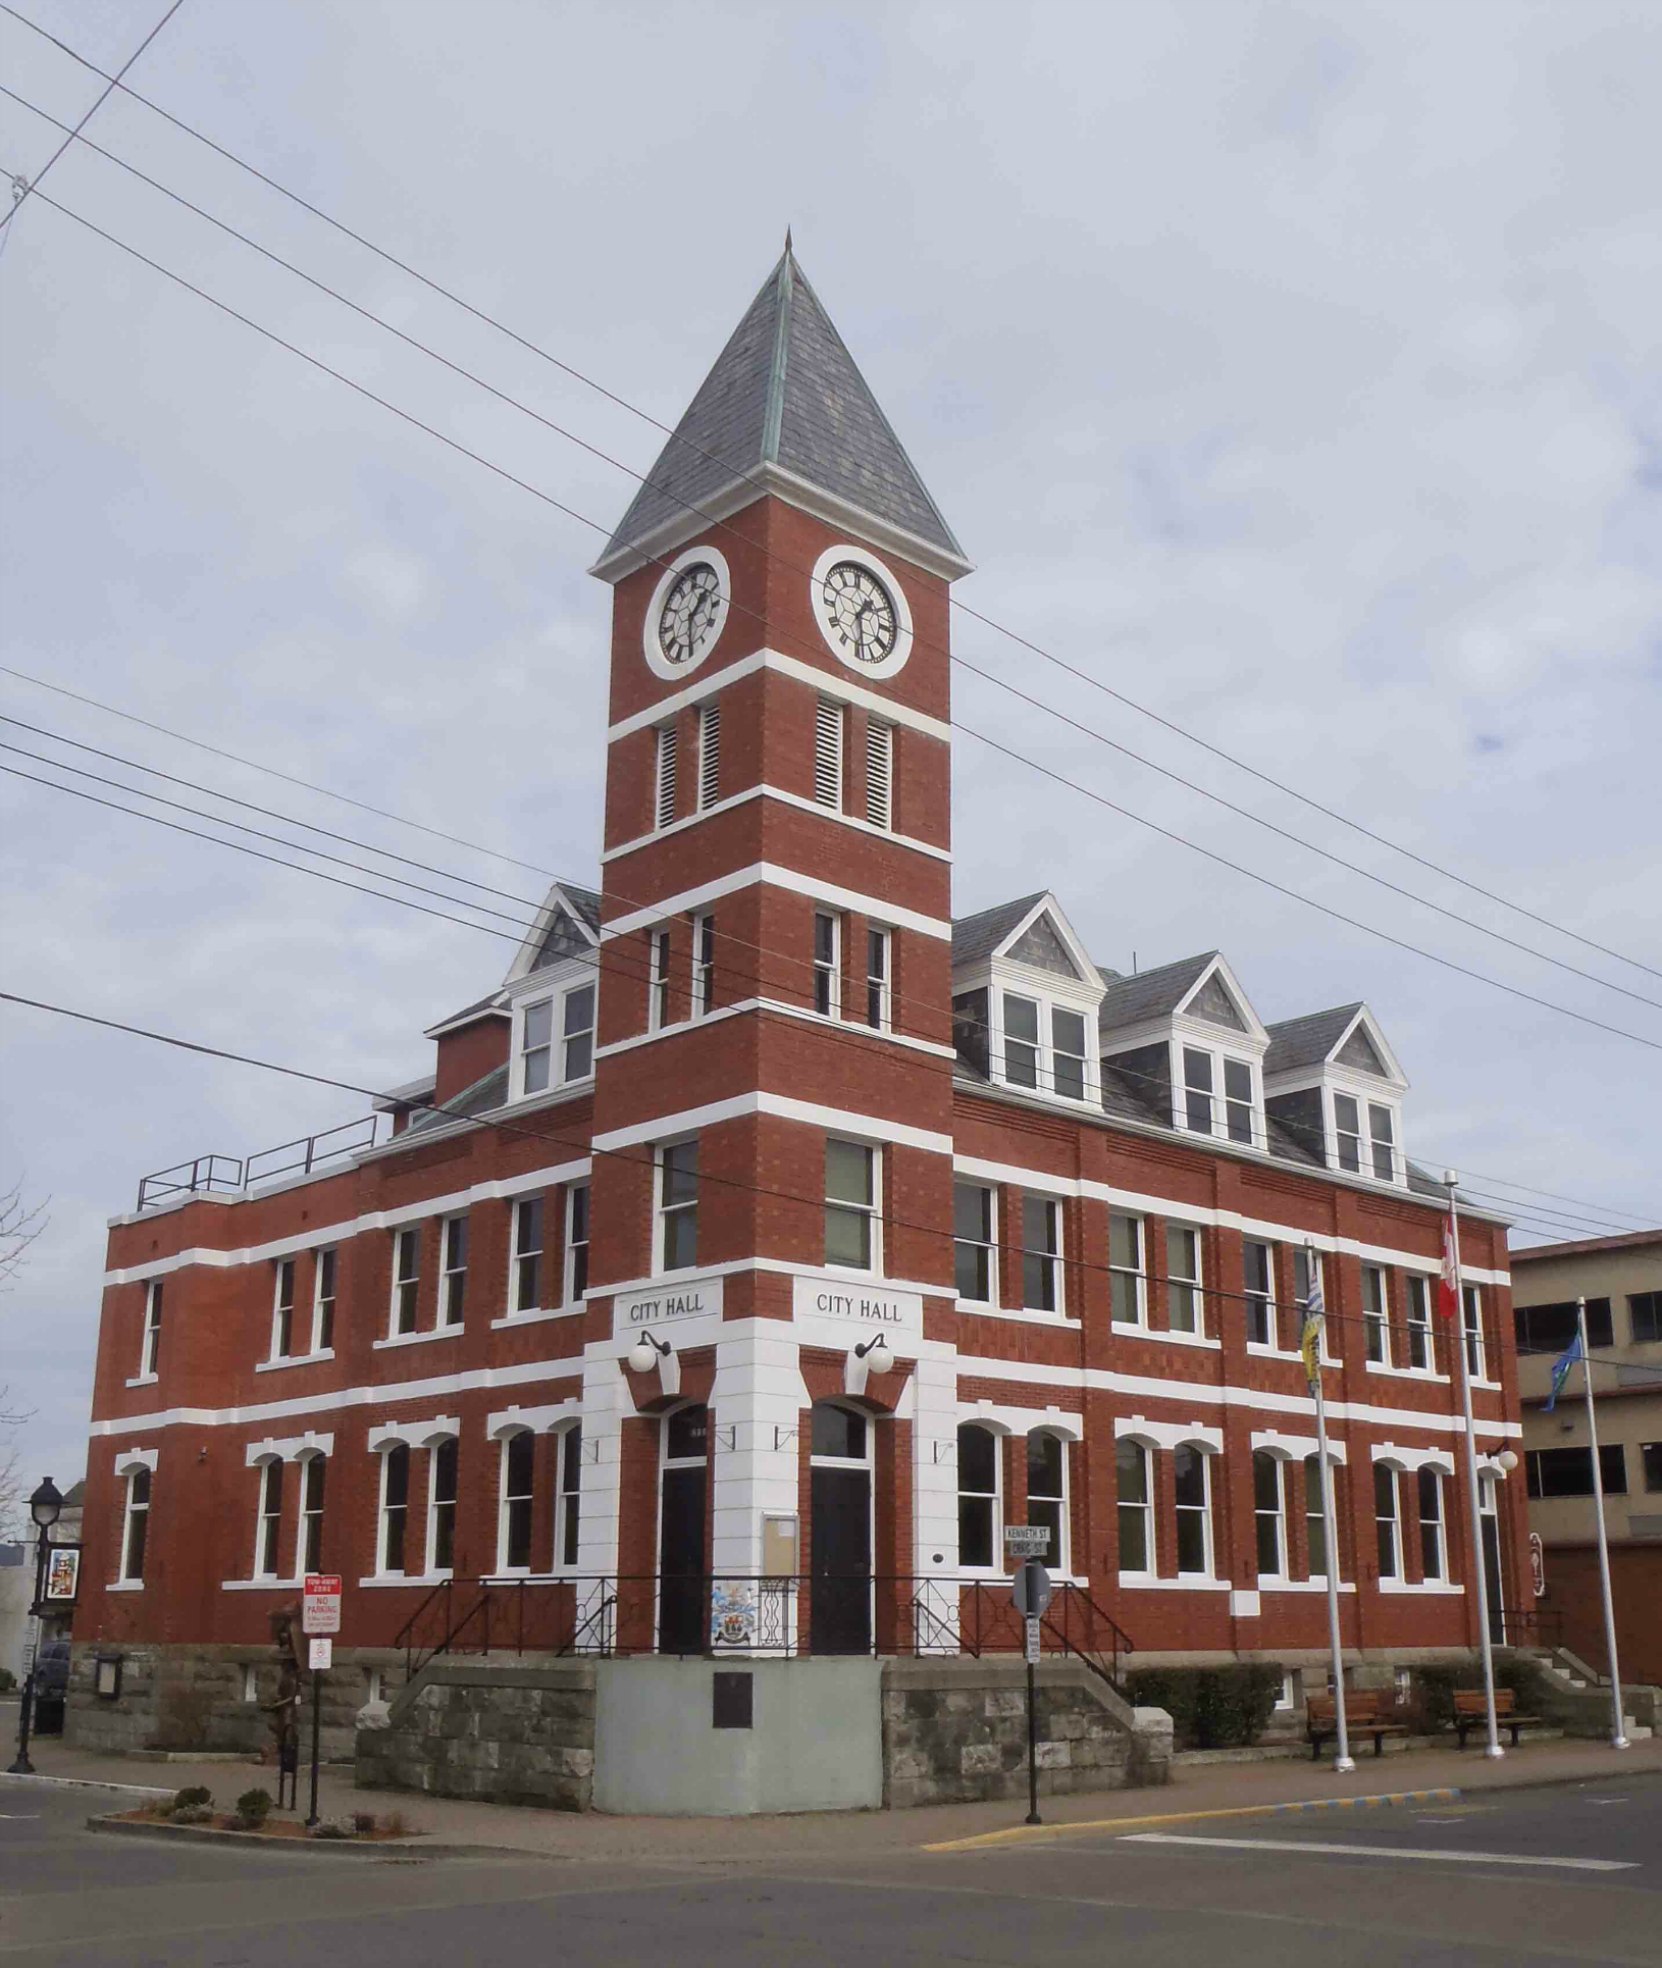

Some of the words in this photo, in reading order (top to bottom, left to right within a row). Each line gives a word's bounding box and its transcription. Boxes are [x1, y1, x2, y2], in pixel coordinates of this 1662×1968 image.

[630, 1300, 661, 1321] CITY
[666, 1293, 704, 1315] HALL
[817, 1293, 853, 1315] CITY
[860, 1299, 902, 1322] HALL
[1007, 1528, 1037, 1538] KENNETH
[1039, 1528, 1047, 1539] ST
[316, 1596, 329, 1605] NO
[307, 1606, 337, 1614] PARKING
